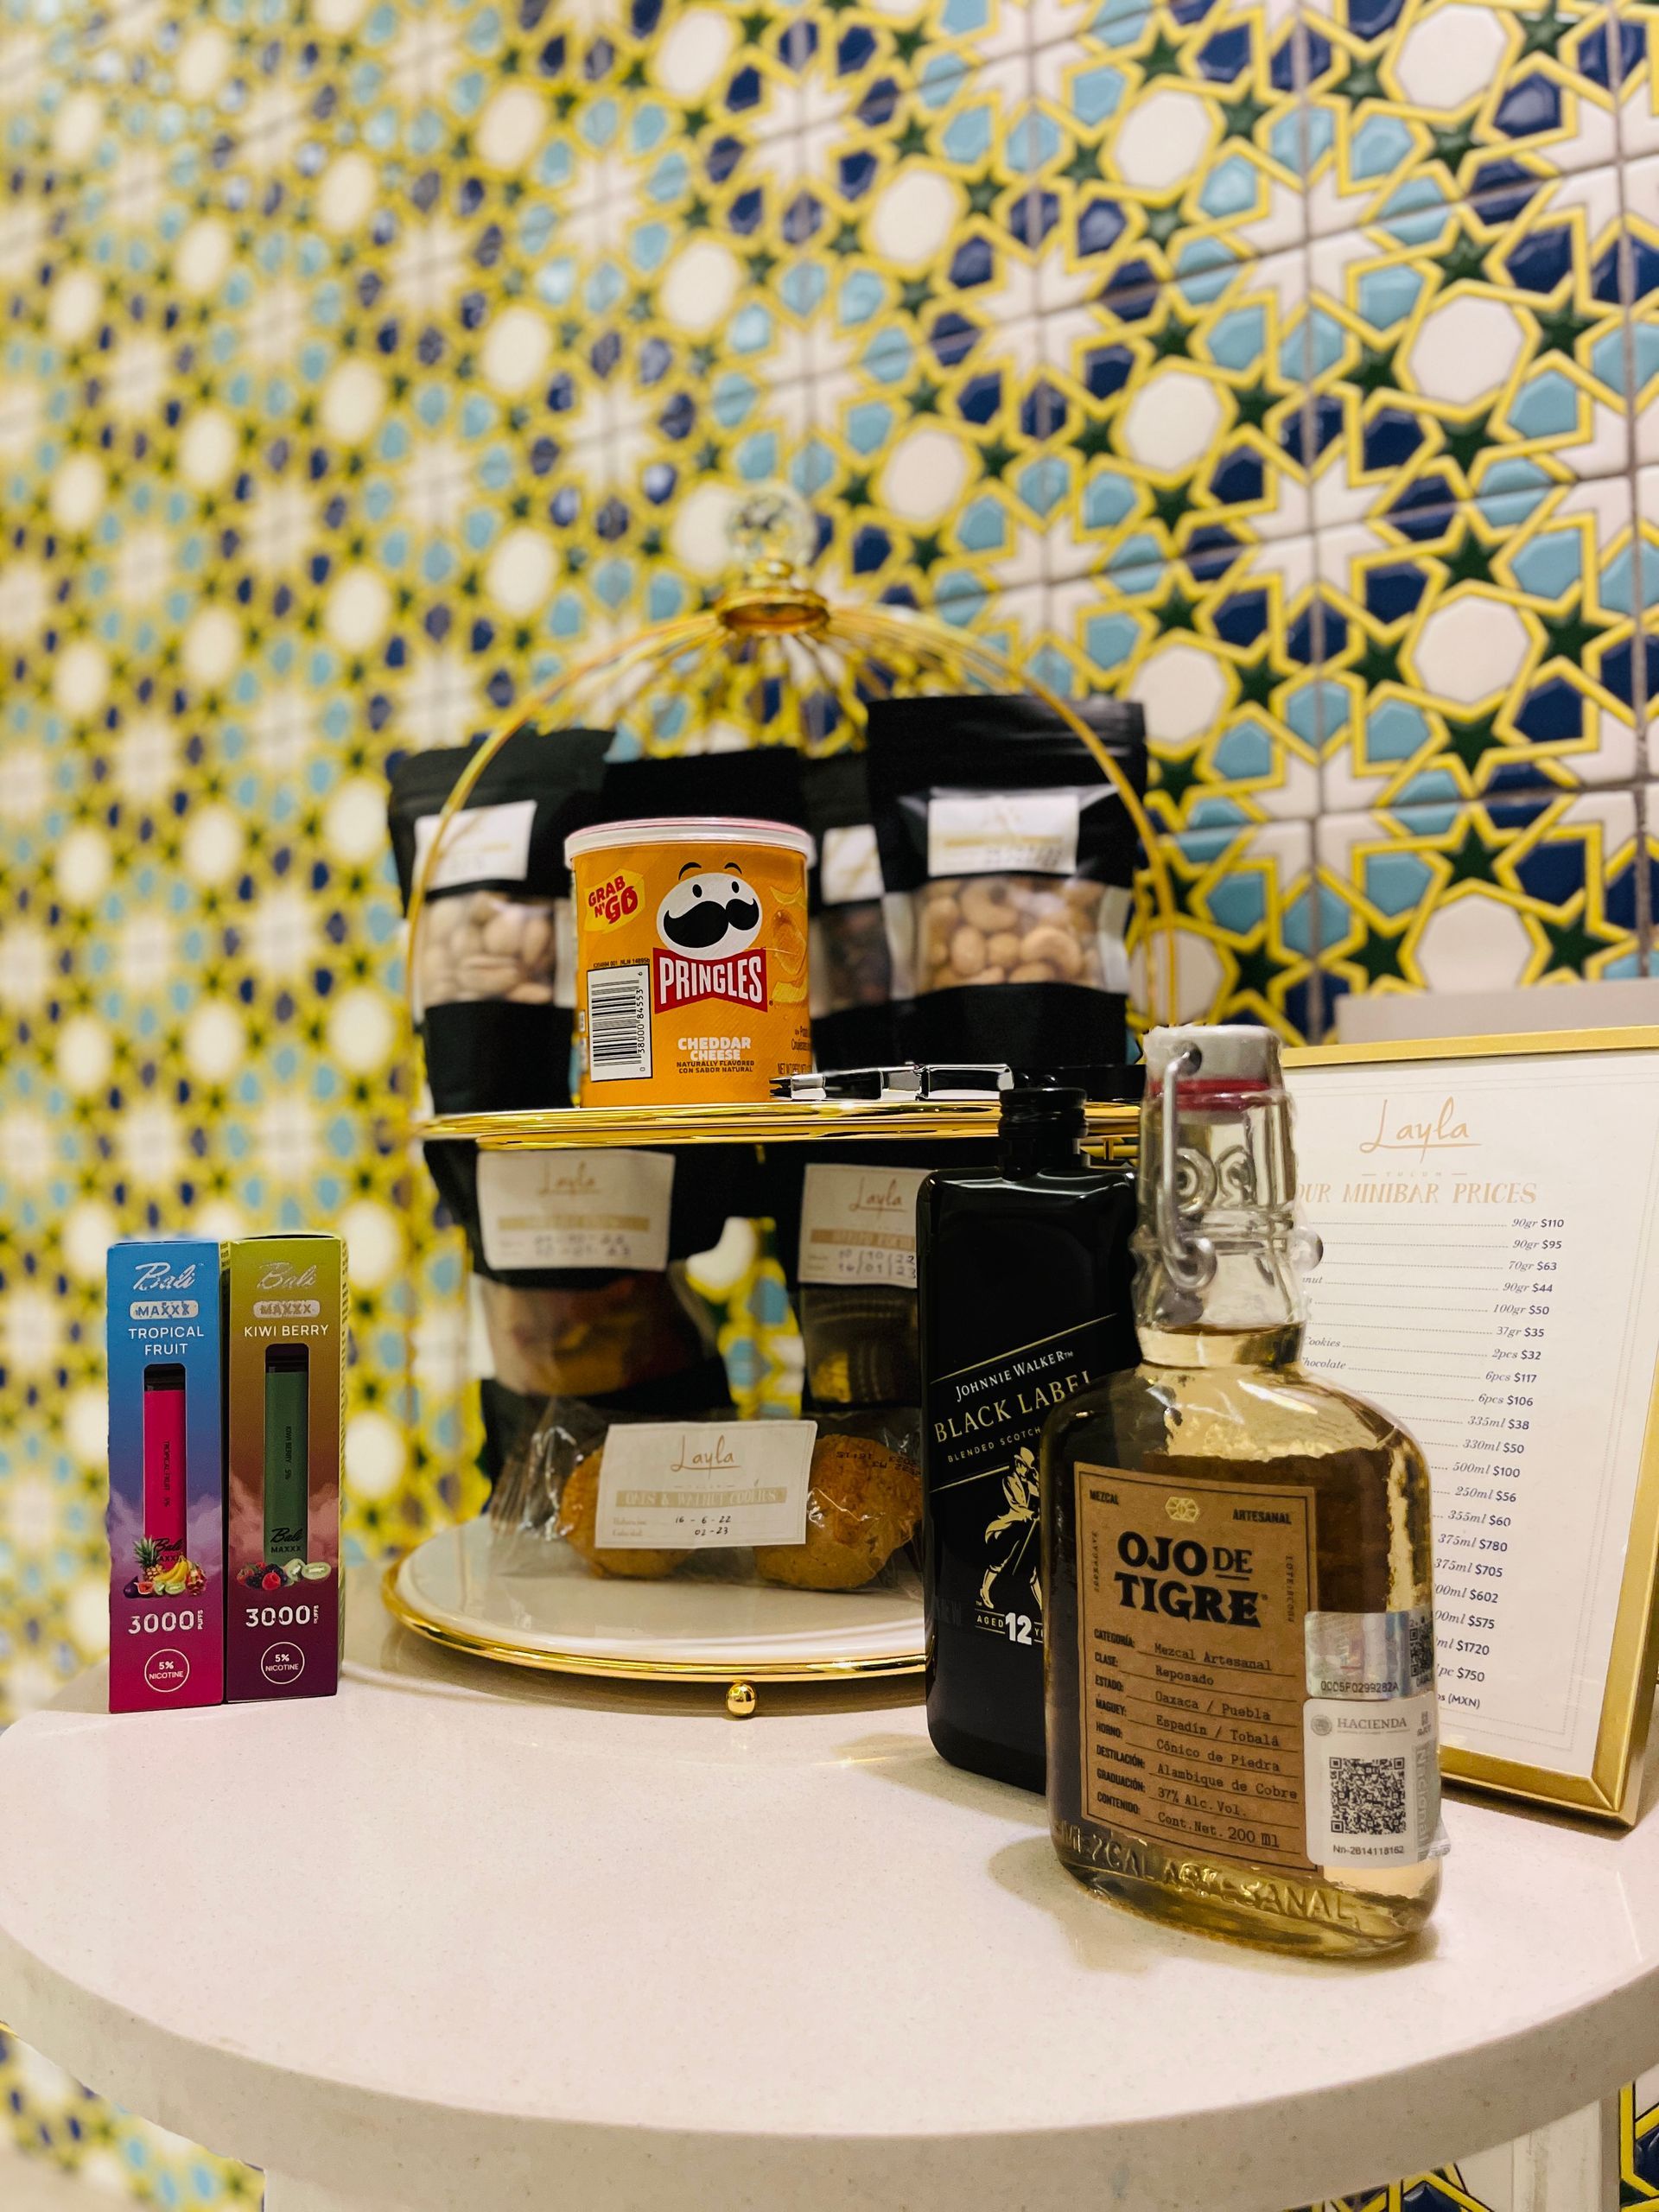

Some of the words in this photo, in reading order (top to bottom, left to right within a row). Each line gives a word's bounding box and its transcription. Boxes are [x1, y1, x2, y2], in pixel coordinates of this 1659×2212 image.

[588, 875, 626, 908] GRAB
[604, 886, 639, 925] GO
[659, 956, 762, 1005] PRINGLES
[636, 988, 645, 1020] 84553
[637, 1024, 645, 1054] 38000
[677, 1037, 751, 1050] CHEDDAR
[690, 1049, 741, 1061] CHEESE
[1359, 1096, 1483, 1164] Layla
[848, 1176, 907, 1219] Layla
[1343, 1182, 1440, 1205] MINIBAR
[1452, 1182, 1537, 1205] PRICES
[1511, 1218, 1539, 1230] 90gr
[1541, 1218, 1565, 1229] $110
[1512, 1239, 1540, 1250] 90gr
[1541, 1239, 1562, 1250] $95
[257, 1262, 317, 1289] Bali
[1509, 1261, 1535, 1272] 70gr
[1536, 1261, 1557, 1272] $63
[133, 1262, 196, 1291] Bali
[1502, 1282, 1529, 1294] 90gr
[1532, 1282, 1553, 1293] $44
[137, 1303, 190, 1317] MAXXX
[260, 1303, 311, 1314] MAXXX
[1492, 1303, 1527, 1315] 100gr
[1529, 1305, 1549, 1315] $50
[129, 1326, 204, 1339] TROPICAL
[245, 1325, 276, 1338] KIWI
[282, 1325, 328, 1337] BERRY
[1496, 1326, 1522, 1338] 37gr
[1523, 1326, 1545, 1338] $35
[145, 1344, 188, 1356] FRUIT
[1491, 1348, 1517, 1360] 2pcs
[1521, 1350, 1541, 1361] $32
[956, 1370, 1012, 1402] JOHNNIE
[1013, 1351, 1065, 1377] WALKER
[1302, 1357, 1346, 1370] hocolate
[1485, 1370, 1511, 1382] 6pcs
[1514, 1372, 1537, 1382] $117
[1478, 1393, 1504, 1405] 6pcs
[1507, 1395, 1534, 1407] $106
[934, 1399, 1012, 1443] BLACK
[1467, 1415, 1505, 1428] 335ml
[1508, 1419, 1529, 1430] $38
[947, 1442, 995, 1463] BLENDED
[1000, 1426, 1041, 1446] SCOTCH
[1463, 1439, 1501, 1452] 330ml
[1503, 1442, 1525, 1454] $50
[671, 1434, 741, 1479] Layla
[1452, 1462, 1491, 1474] 500ml
[1493, 1465, 1520, 1478] $100
[1089, 1489, 1119, 1505] MEZCAL
[1455, 1486, 1493, 1500] 250ml
[1496, 1491, 1516, 1503] $56
[1233, 1510, 1292, 1525] ARTESANAL
[1447, 1510, 1487, 1523] 355ml
[1489, 1515, 1511, 1527] $60
[270, 1528, 302, 1543] Bali
[1438, 1534, 1477, 1548] 375ml
[1479, 1539, 1508, 1552] $780
[153, 1538, 182, 1552] Bali
[271, 1545, 302, 1554] MAXXX
[1117, 1530, 1208, 1577] OJO
[1213, 1547, 1253, 1574] DE
[1434, 1558, 1472, 1573] 375ml
[1475, 1564, 1503, 1578] $705
[1114, 1571, 1262, 1628] TIGRE
[1434, 1583, 1467, 1599] 00ml
[1469, 1588, 1498, 1604] $602
[129, 1611, 194, 1634] 3000
[245, 1605, 311, 1627] 3000
[1434, 1610, 1465, 1624] 00ml
[1469, 1615, 1495, 1630] $575
[976, 1614, 1004, 1628] AGED
[1005, 1612, 1032, 1645] 12
[1094, 1628, 1135, 1648] CATEGORÍA:
[1154, 1643, 1196, 1661] Mezcal
[1204, 1651, 1273, 1671] Artesanal
[1436, 1636, 1454, 1649] ml
[1456, 1639, 1490, 1656] $1720
[159, 1661, 175, 1670] 5%
[275, 1654, 290, 1662] 5%
[149, 1670, 184, 1681] NICOTINE
[265, 1663, 299, 1672] NICOTINE
[1094, 1651, 1118, 1667] CLASE:
[1155, 1665, 1214, 1686] Reposado
[1457, 1667, 1485, 1682] $750
[1095, 1675, 1123, 1692] ESTADO:
[1155, 1691, 1199, 1710] Oaxaca
[1222, 1703, 1271, 1720] Puebla
[1448, 1693, 1480, 1710] (MXN)
[1096, 1698, 1127, 1717] MAGUEY:
[1156, 1714, 1207, 1736] Espadín
[1231, 1729, 1280, 1747] Tobalá
[1338, 1717, 1408, 1729] HACIENDA
[1096, 1721, 1122, 1738] HORNO:
[1157, 1738, 1199, 1758] Cónico
[1208, 1751, 1223, 1762] de
[1231, 1754, 1280, 1772] Piedra
[1096, 1745, 1146, 1769] DESTILACIÓN:
[1157, 1764, 1224, 1789] Alambique
[1232, 1779, 1248, 1792] de
[1255, 1783, 1298, 1799] Cobre
[1096, 1768, 1146, 1793] GRADUACIÓN:
[1158, 1786, 1179, 1803] 37%
[1097, 1791, 1141, 1815] CONTENIDO:
[1228, 1826, 1255, 1843] 200
[1262, 1832, 1280, 1848] ml
